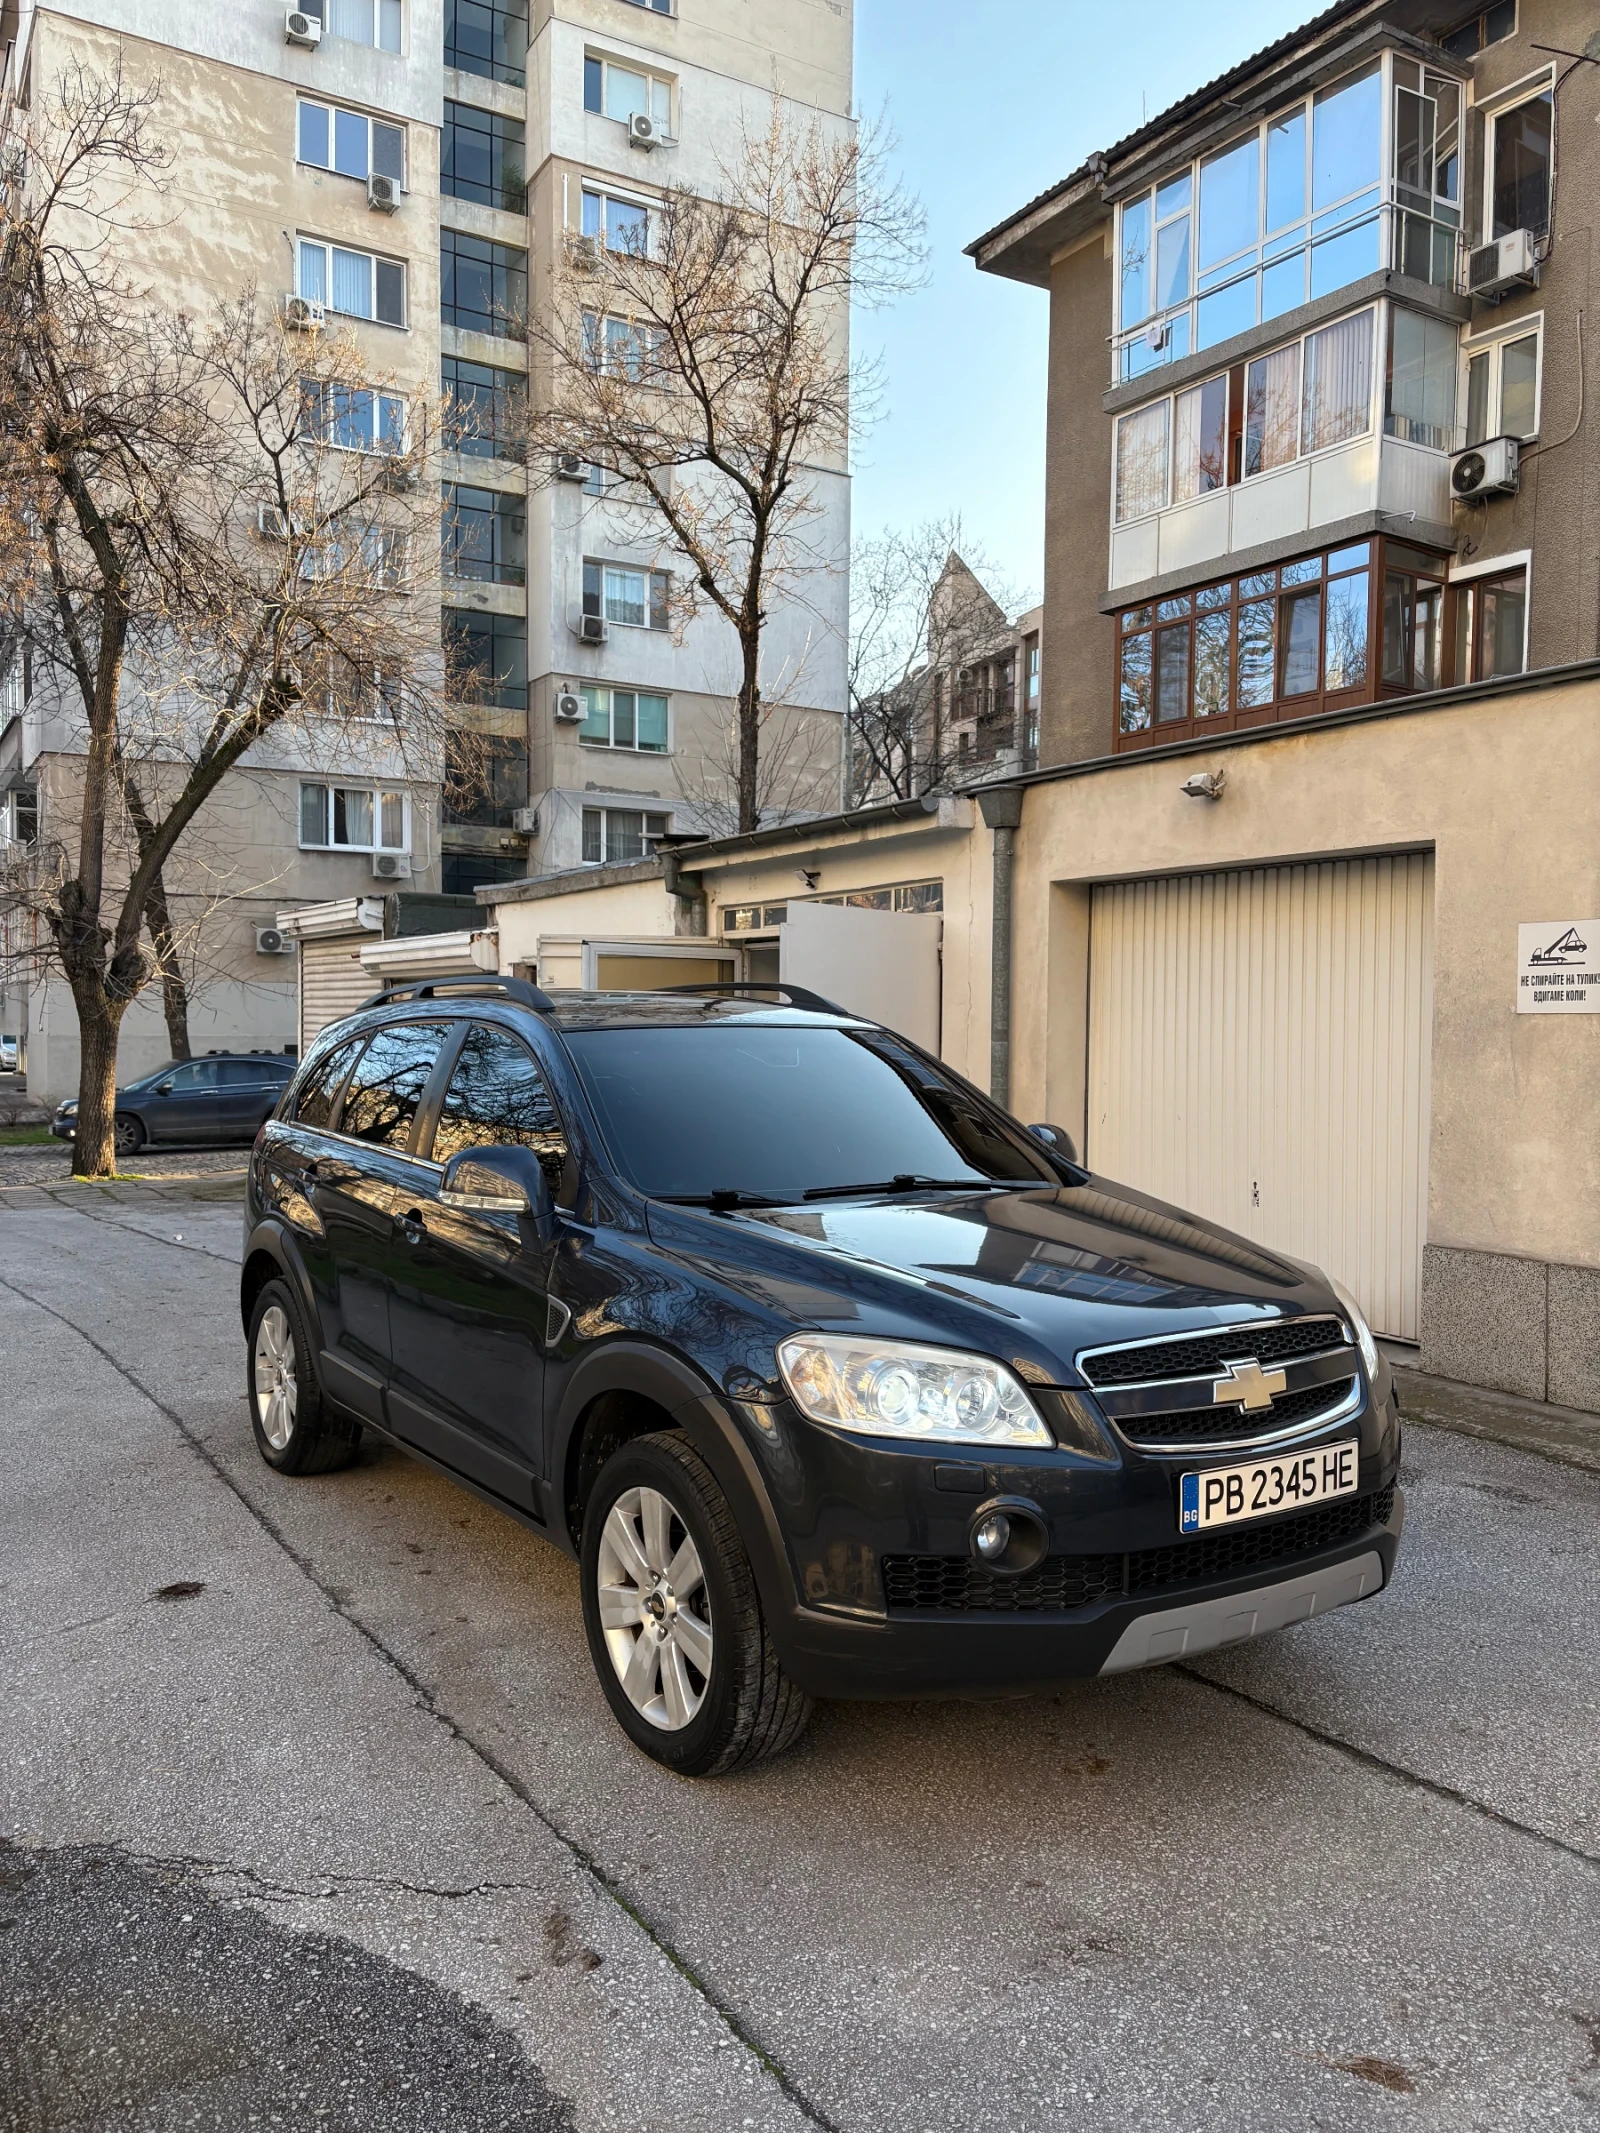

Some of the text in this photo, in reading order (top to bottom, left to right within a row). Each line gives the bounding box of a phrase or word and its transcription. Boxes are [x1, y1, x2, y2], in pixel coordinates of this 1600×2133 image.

[1521, 975, 1529, 986] НЕ
[1531, 973, 1564, 986] СПИРАЙТЕ
[1566, 974, 1575, 985] НА
[1534, 990, 1586, 1003] ВДИГАМЕ КОЛИ!
[1205, 1448, 1354, 1520] PB 2345 HE
[1183, 1509, 1198, 1524] BG
